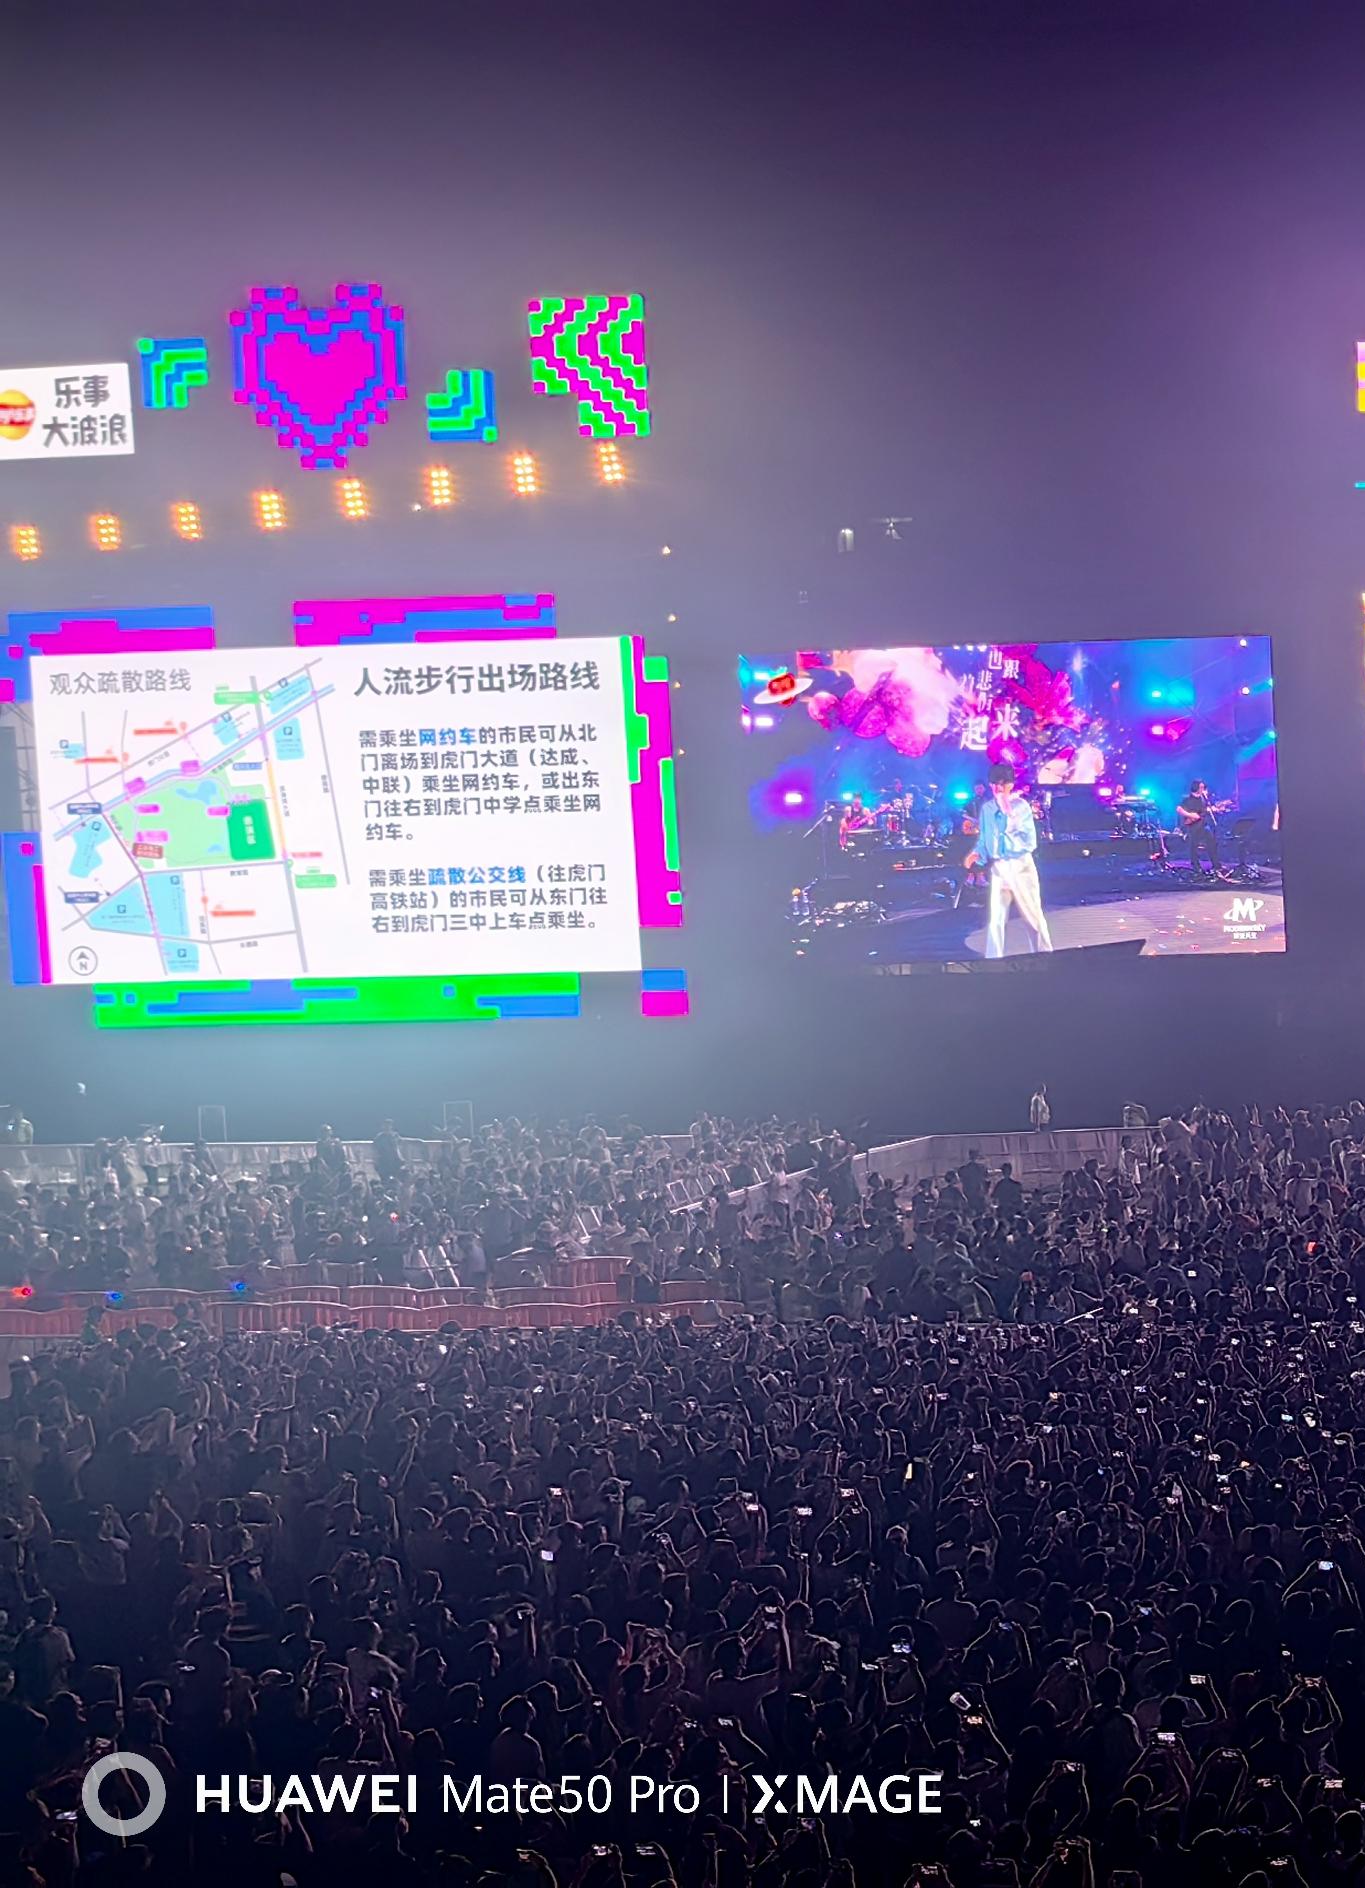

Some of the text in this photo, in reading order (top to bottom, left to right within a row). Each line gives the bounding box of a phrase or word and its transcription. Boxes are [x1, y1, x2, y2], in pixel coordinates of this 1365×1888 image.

[54, 375, 110, 409] 乐事
[42, 413, 127, 448] 大波浪
[50, 668, 192, 696] 观众疏散路线
[354, 661, 600, 697] 人流步行出场路线
[359, 724, 597, 749] 需乘坐网约车的市民可从北
[364, 794, 601, 818] 门往右到虎门中学点乘坐网
[366, 823, 414, 841] 约车。
[369, 864, 606, 887] 需乘坐疏散公交线（往虎门
[371, 887, 608, 911] 高铁站）的市民可从东门往
[372, 910, 597, 933] 右到虎门三中上车点乘坐。
